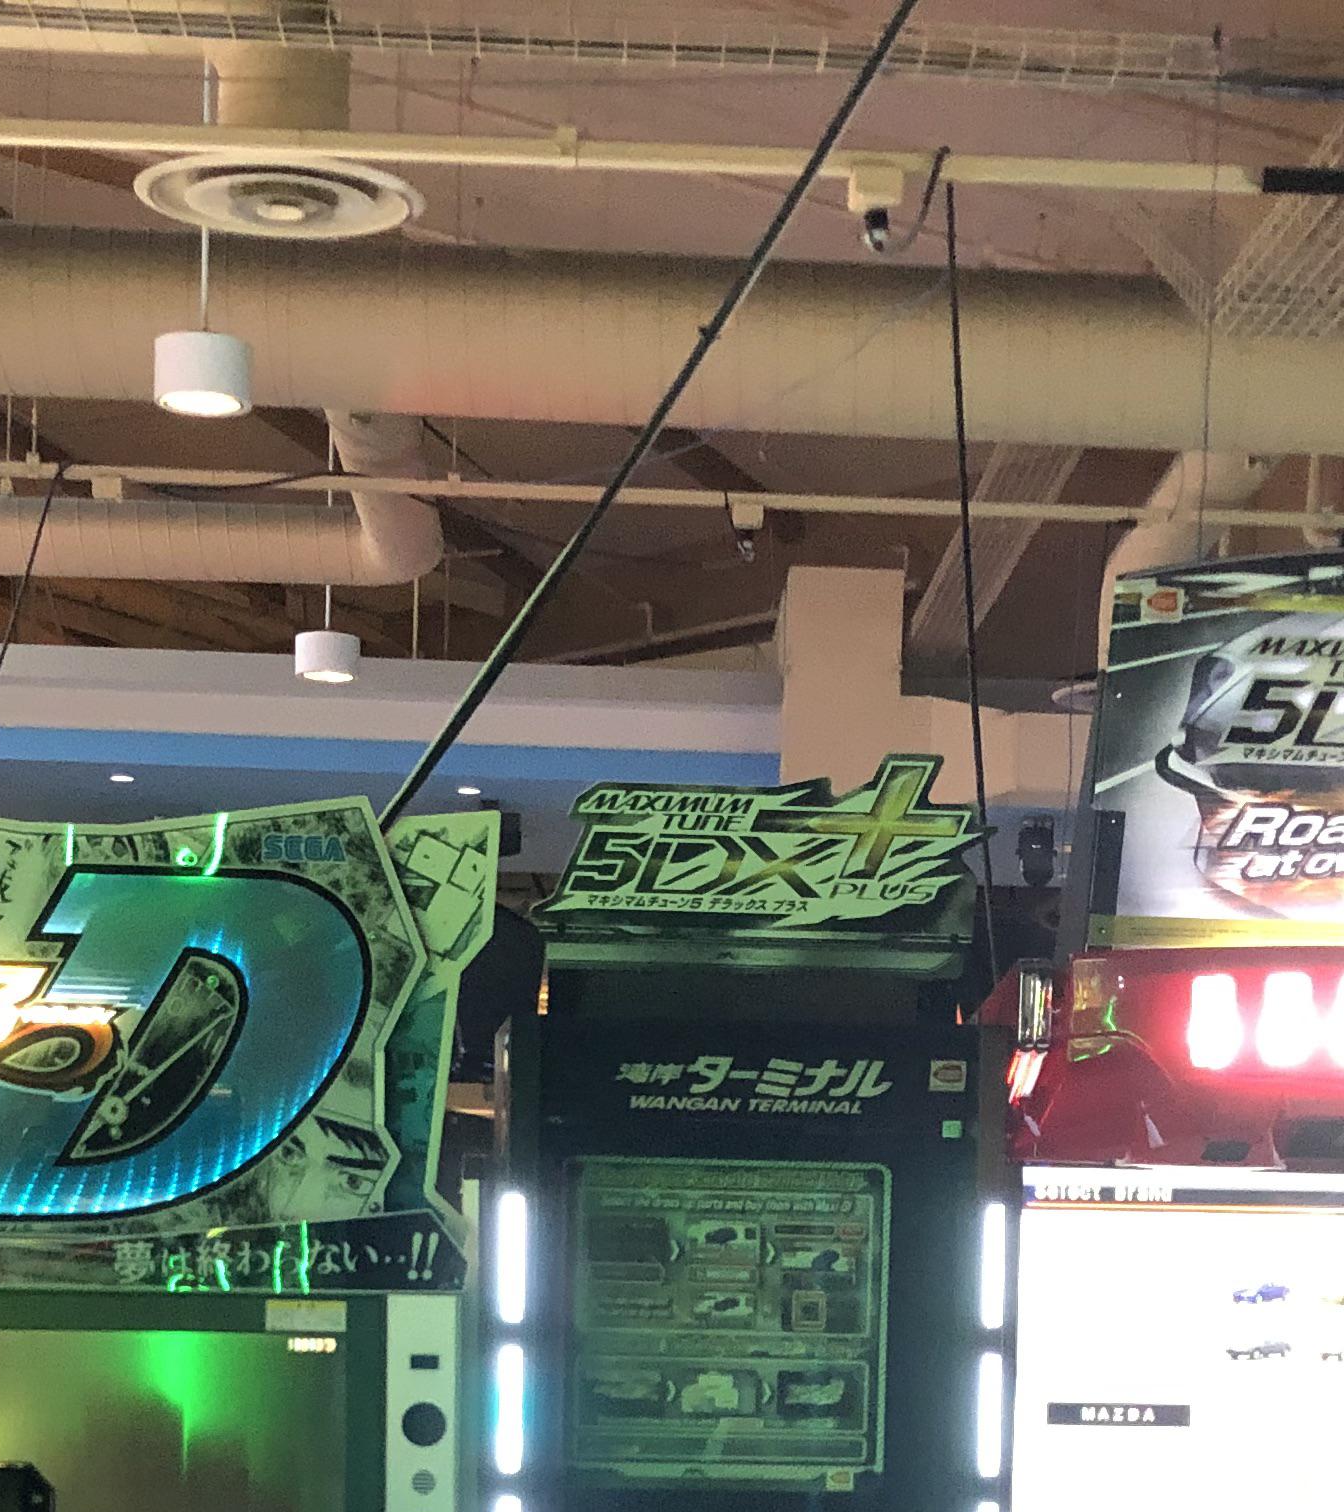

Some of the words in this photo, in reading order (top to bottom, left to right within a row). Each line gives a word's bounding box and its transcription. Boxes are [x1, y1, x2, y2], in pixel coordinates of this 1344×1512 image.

[583, 789, 754, 815] MAXIMUM
[662, 813, 747, 833] TUNE
[262, 834, 348, 863] SEGA
[829, 881, 941, 902] PLUS
[629, 1095, 743, 1112] WANGAN
[747, 1098, 863, 1115] TERMINAL
[1080, 1406, 1157, 1423] MAZDA
